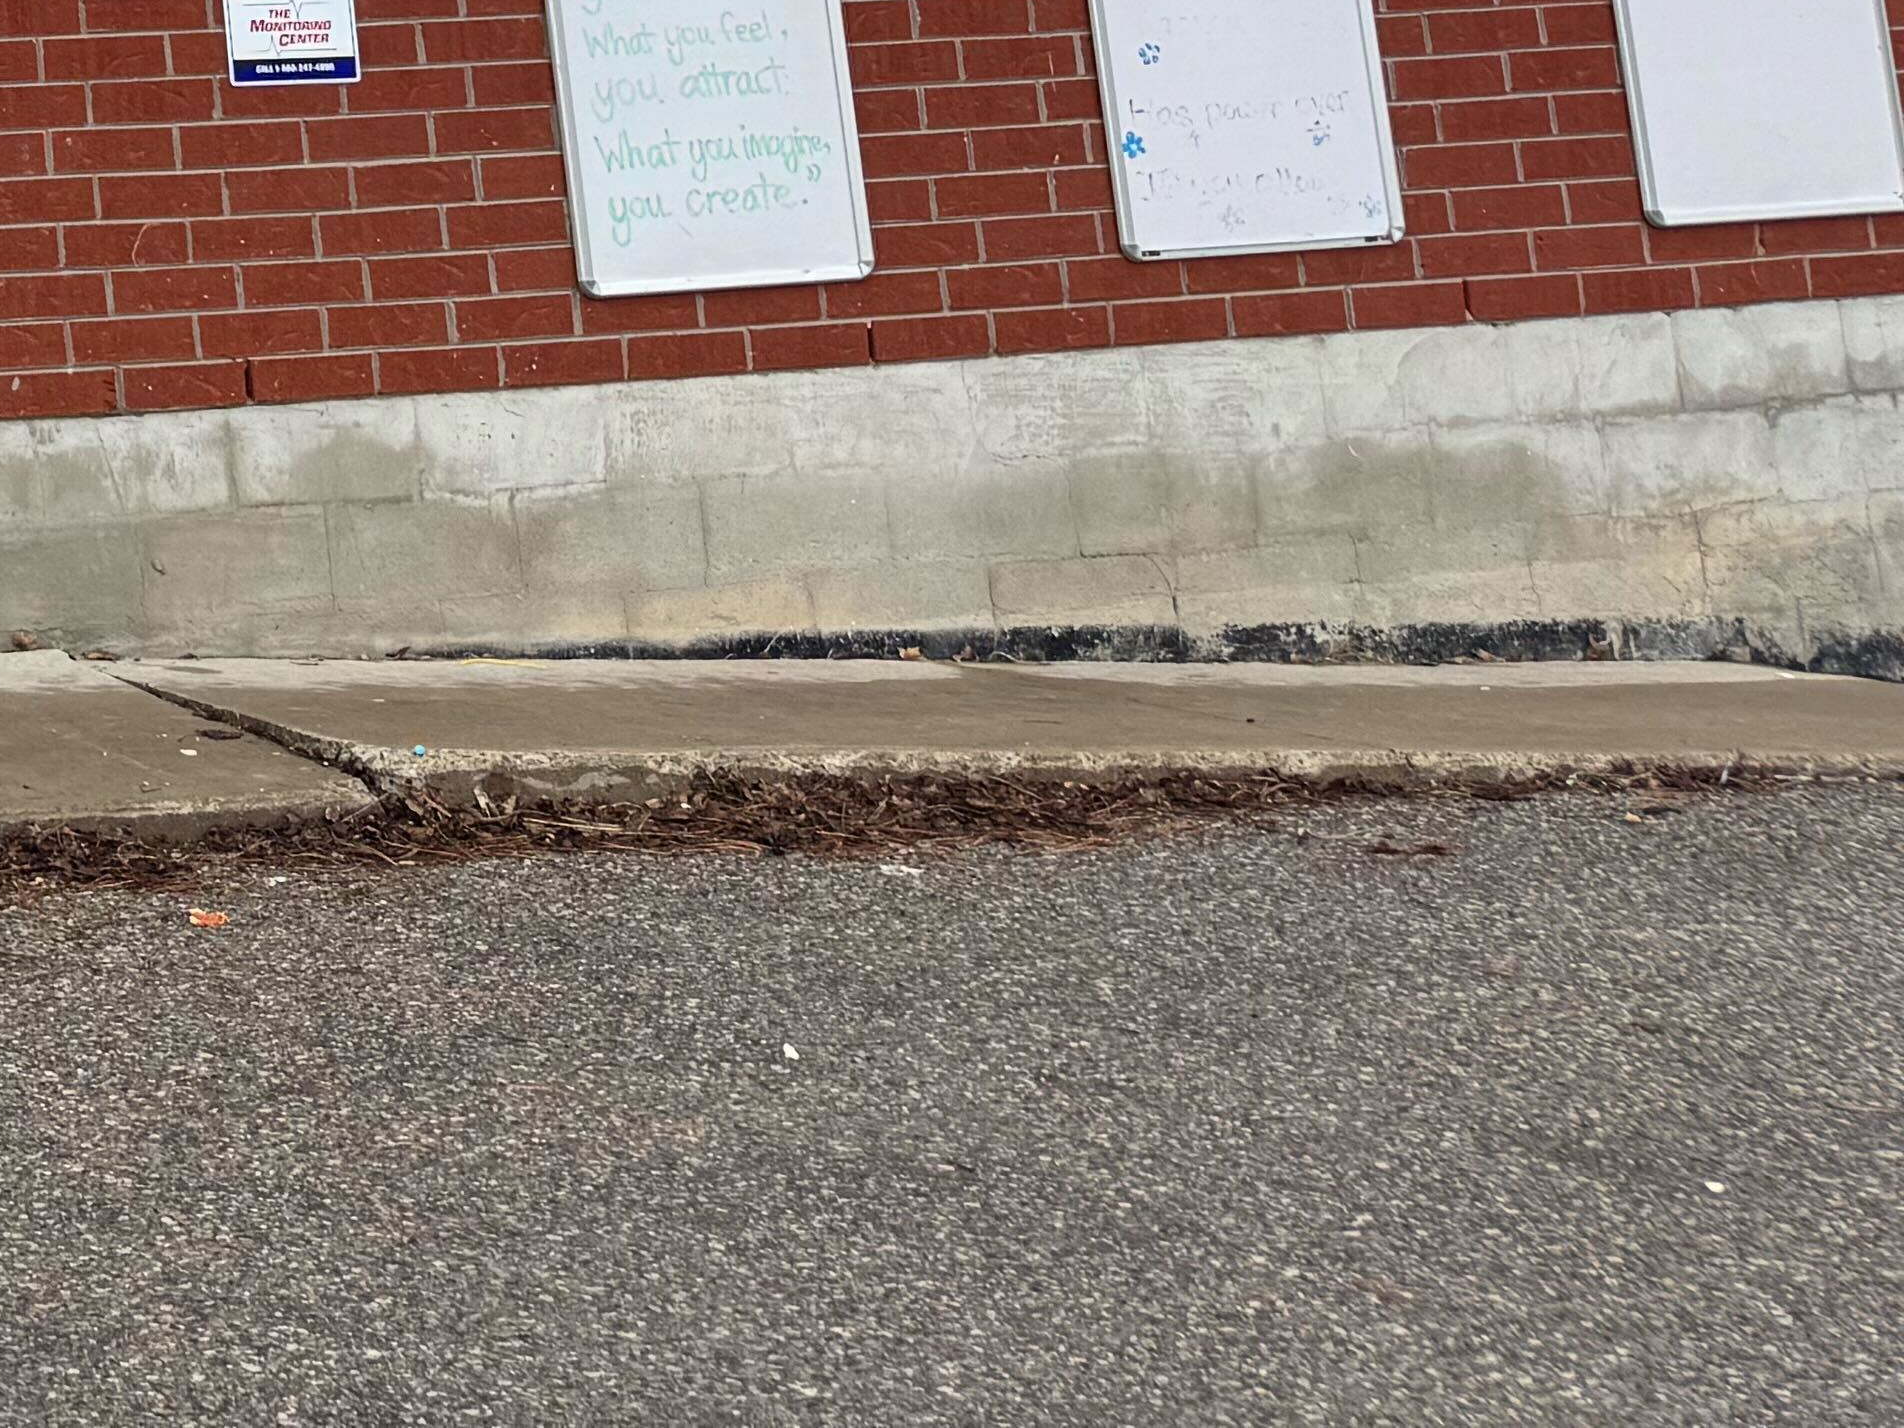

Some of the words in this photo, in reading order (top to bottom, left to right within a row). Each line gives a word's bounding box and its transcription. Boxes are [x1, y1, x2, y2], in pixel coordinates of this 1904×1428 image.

[269, 9, 292, 19] THE
[582, 22, 657, 61] What
[593, 127, 682, 174] What
[689, 135, 737, 183] you
[607, 189, 673, 247] you
